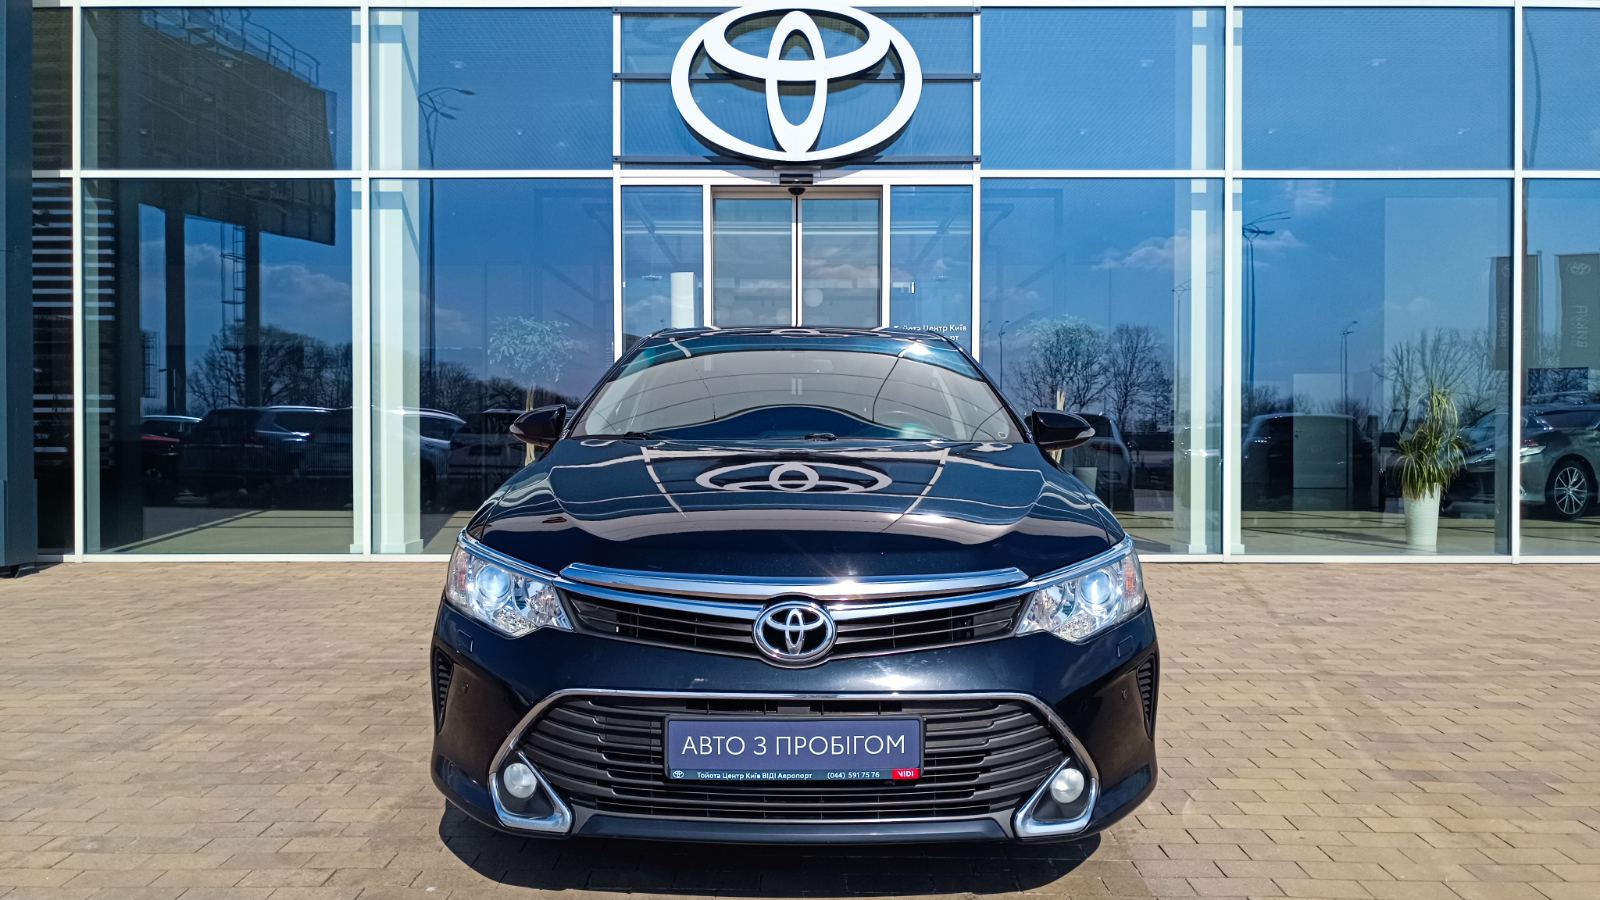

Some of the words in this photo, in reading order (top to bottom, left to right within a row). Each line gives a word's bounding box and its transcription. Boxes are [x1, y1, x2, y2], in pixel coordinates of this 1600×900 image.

[682, 736, 745, 756] АВТО
[776, 735, 905, 756] ПРОБІГОМ
[722, 772, 745, 780] Центр
[762, 772, 777, 780] ВІДІ
[778, 772, 813, 780] Аеропорт
